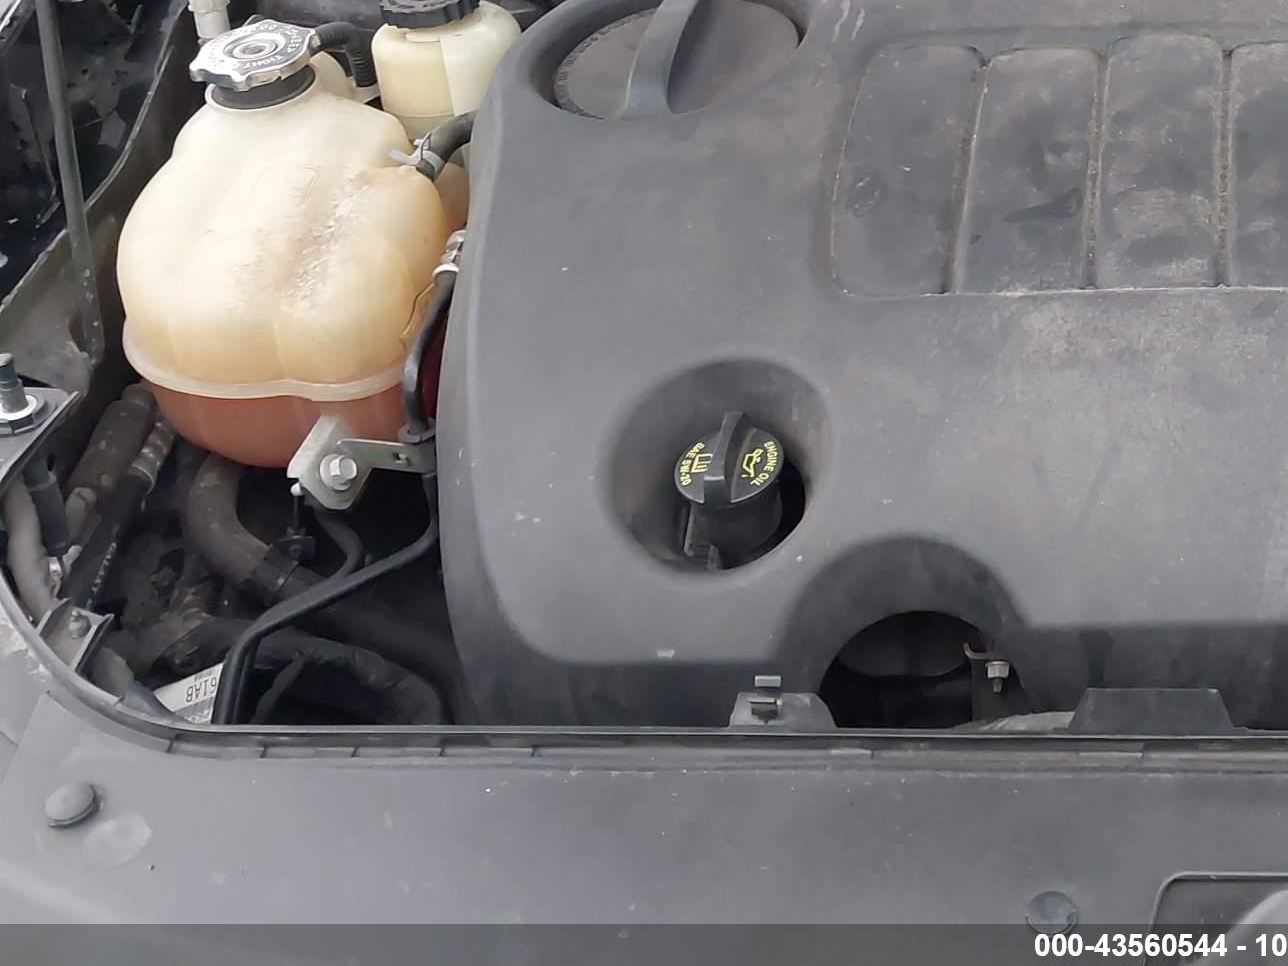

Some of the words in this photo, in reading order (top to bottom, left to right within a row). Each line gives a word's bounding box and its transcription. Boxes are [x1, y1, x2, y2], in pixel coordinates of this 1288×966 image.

[686, 442, 706, 459] SAE
[763, 440, 779, 472] ENGINE
[750, 472, 770, 487] OIL
